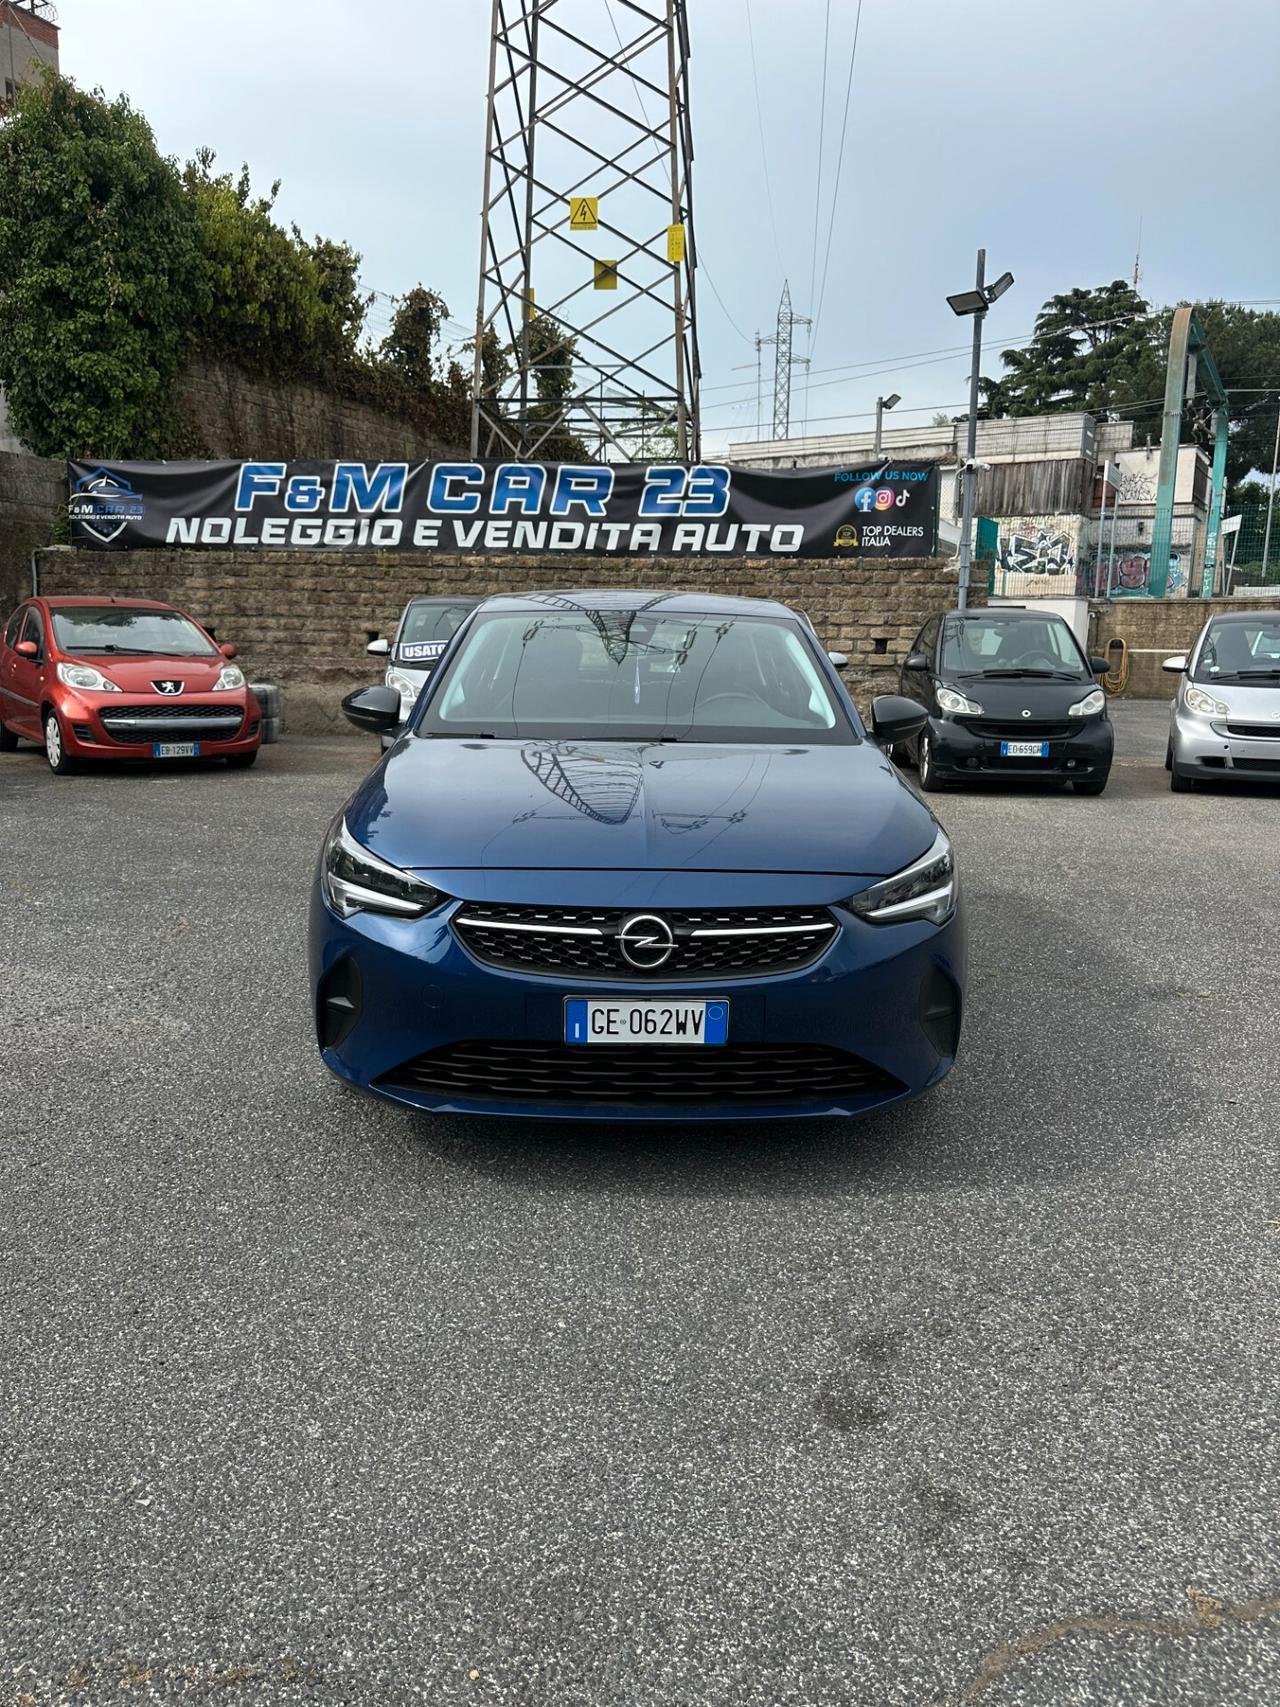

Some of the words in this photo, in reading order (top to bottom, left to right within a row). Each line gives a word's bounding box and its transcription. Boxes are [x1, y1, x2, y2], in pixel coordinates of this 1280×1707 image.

[834, 470, 881, 482] FOLLOW
[885, 470, 900, 481] US
[902, 470, 929, 482] NOW
[235, 462, 409, 513] F&M
[427, 463, 615, 517] CAR
[638, 465, 731, 518] 23
[166, 517, 403, 547] NOLEGGIO
[413, 519, 443, 547] E
[453, 520, 662, 552] VENDITA
[672, 523, 805, 552] AUTO
[862, 525, 882, 537] TOP
[883, 525, 924, 537] DEALERS
[861, 536, 891, 547] ITALIA
[591, 1008, 620, 1036] GE
[629, 1008, 704, 1036] 062WV
